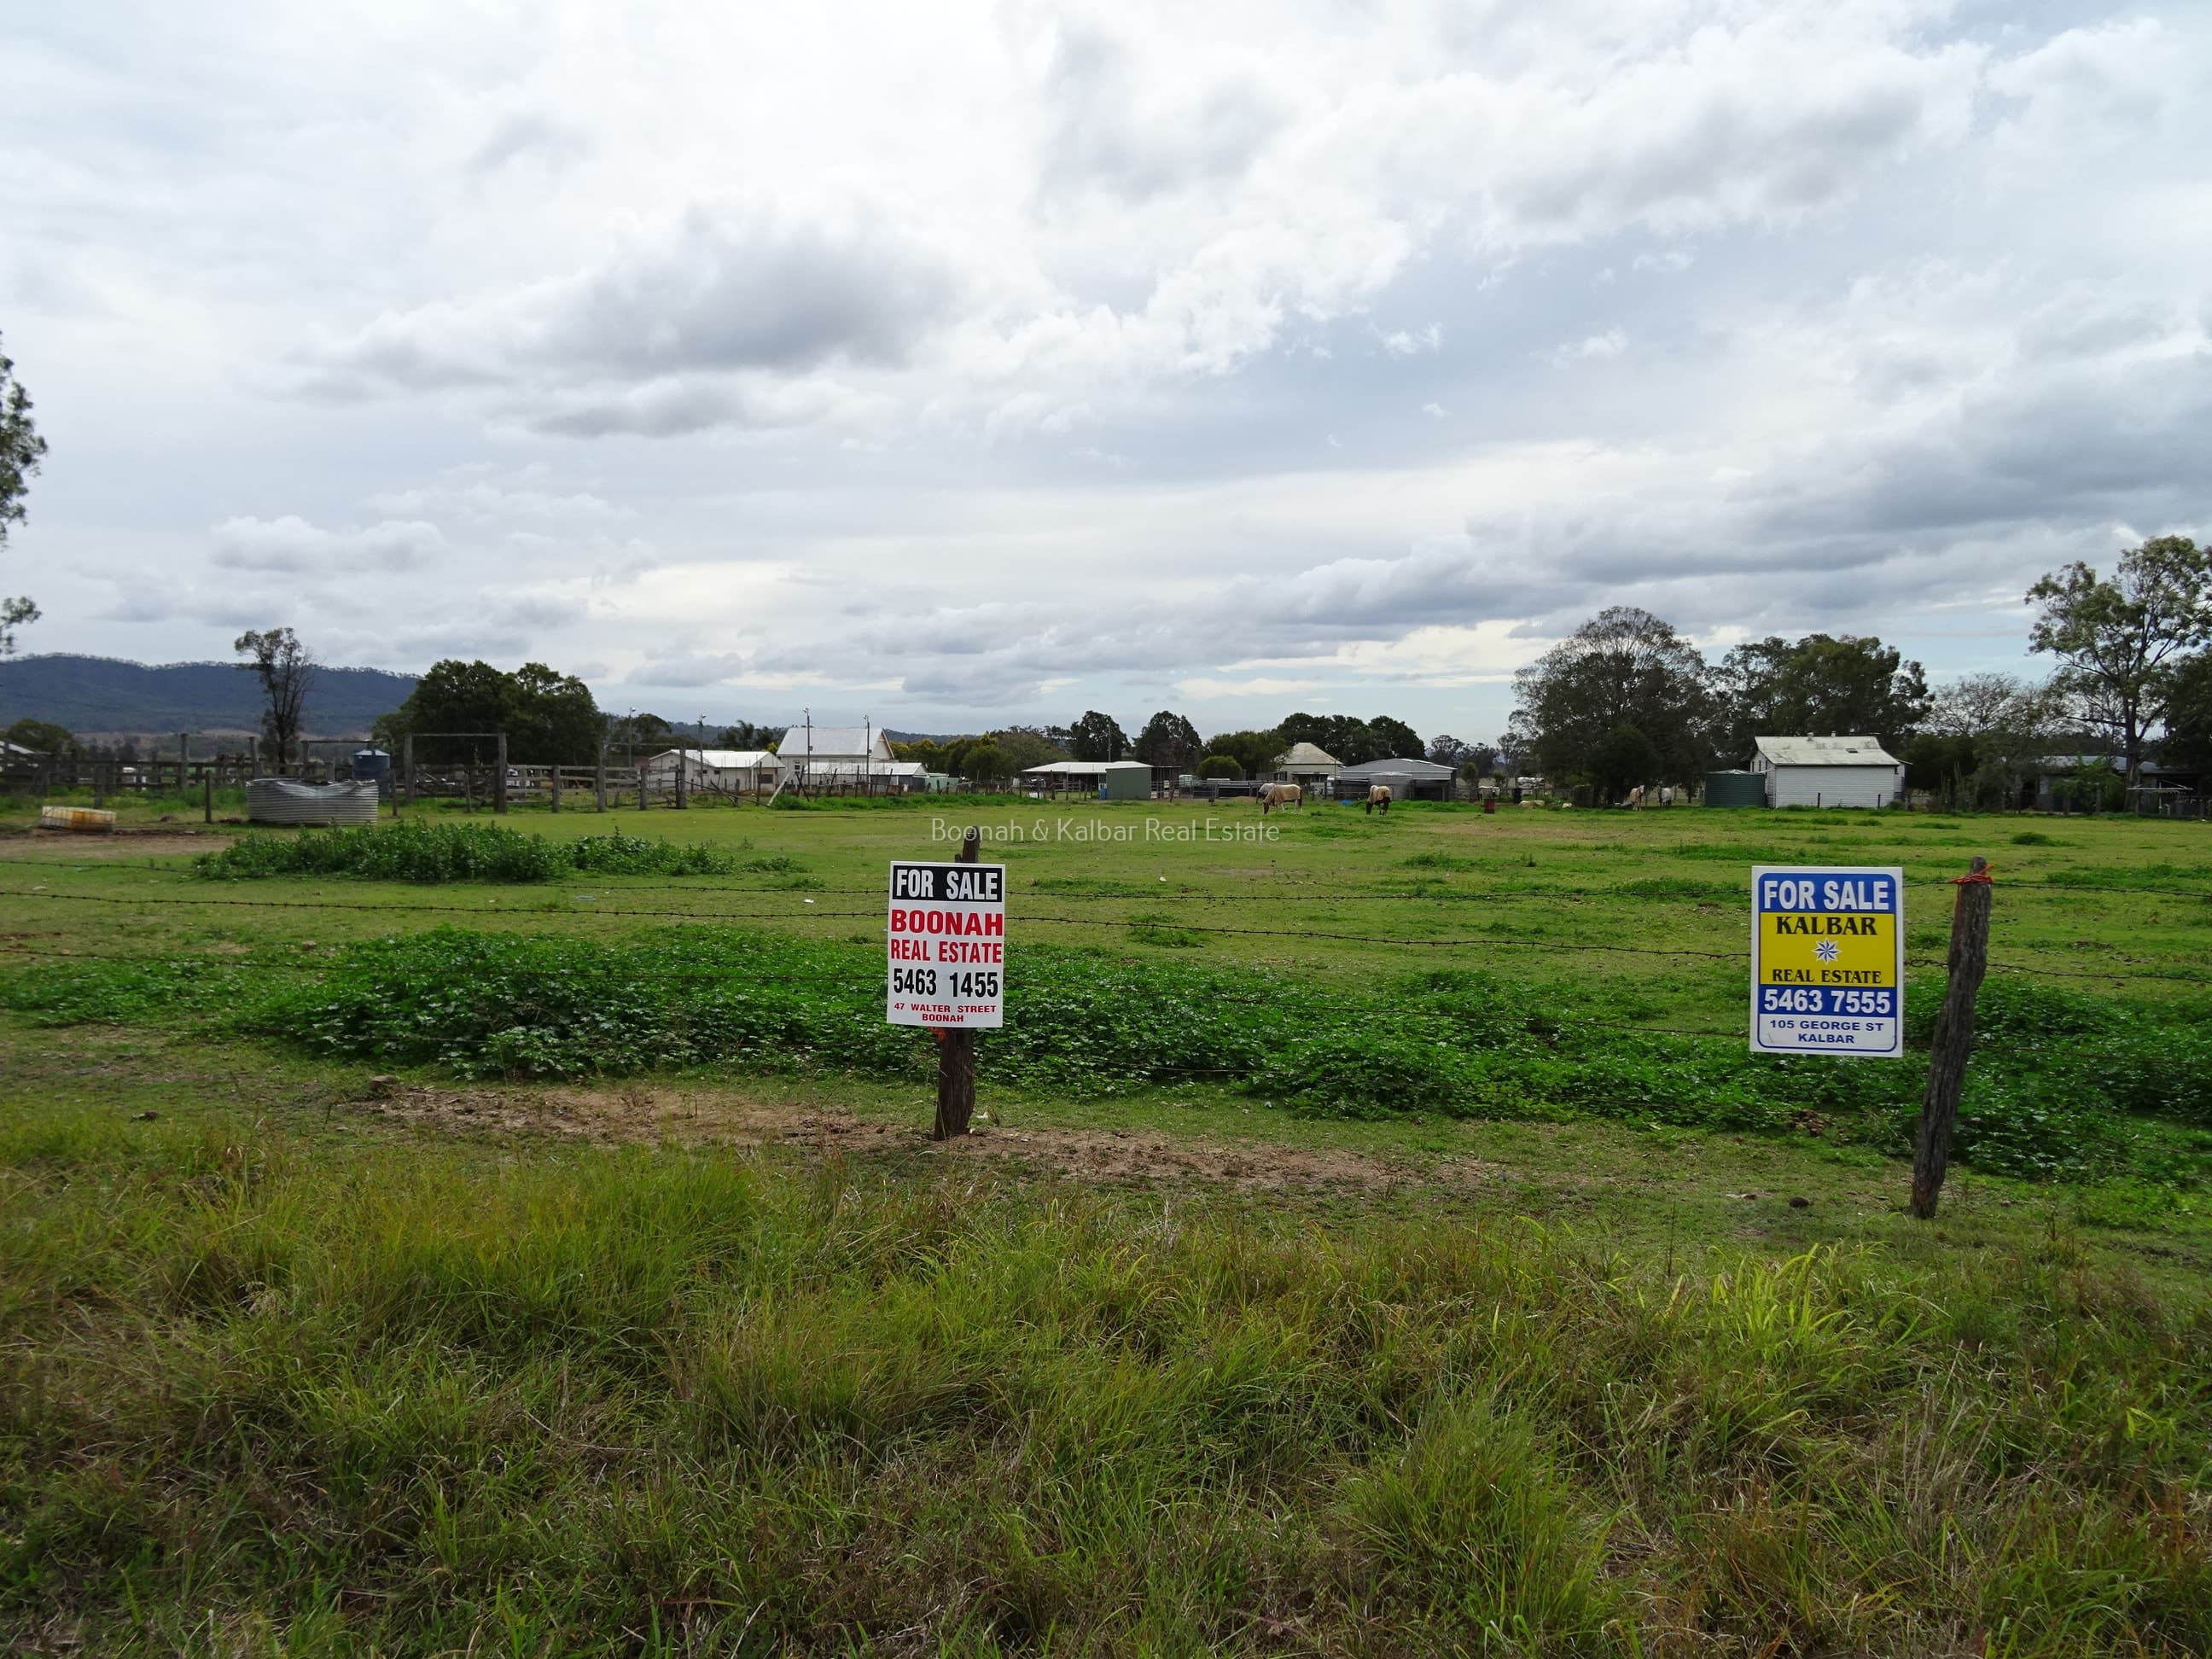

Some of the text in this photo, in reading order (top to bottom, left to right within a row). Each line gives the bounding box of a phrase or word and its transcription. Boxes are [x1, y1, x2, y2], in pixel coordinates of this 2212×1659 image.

[896, 869, 998, 900] FOR SALE
[1764, 880, 1889, 911] FOR SALE
[891, 909, 1003, 936] BOONAH
[1775, 916, 1877, 935] KALBAR
[890, 939, 1002, 963] REAL ESTATE
[894, 968, 998, 998] 5463 1455
[1773, 969, 1882, 984] REAL ESTATE
[911, 1004, 951, 1013] WALTER
[958, 1004, 997, 1013] STREET
[1764, 989, 1891, 1014] 5463 7555
[922, 1013, 964, 1022] BOONAH
[1770, 1020, 1884, 1032] 105 GEORGE ST
[1798, 1033, 1854, 1044] KALBAR
